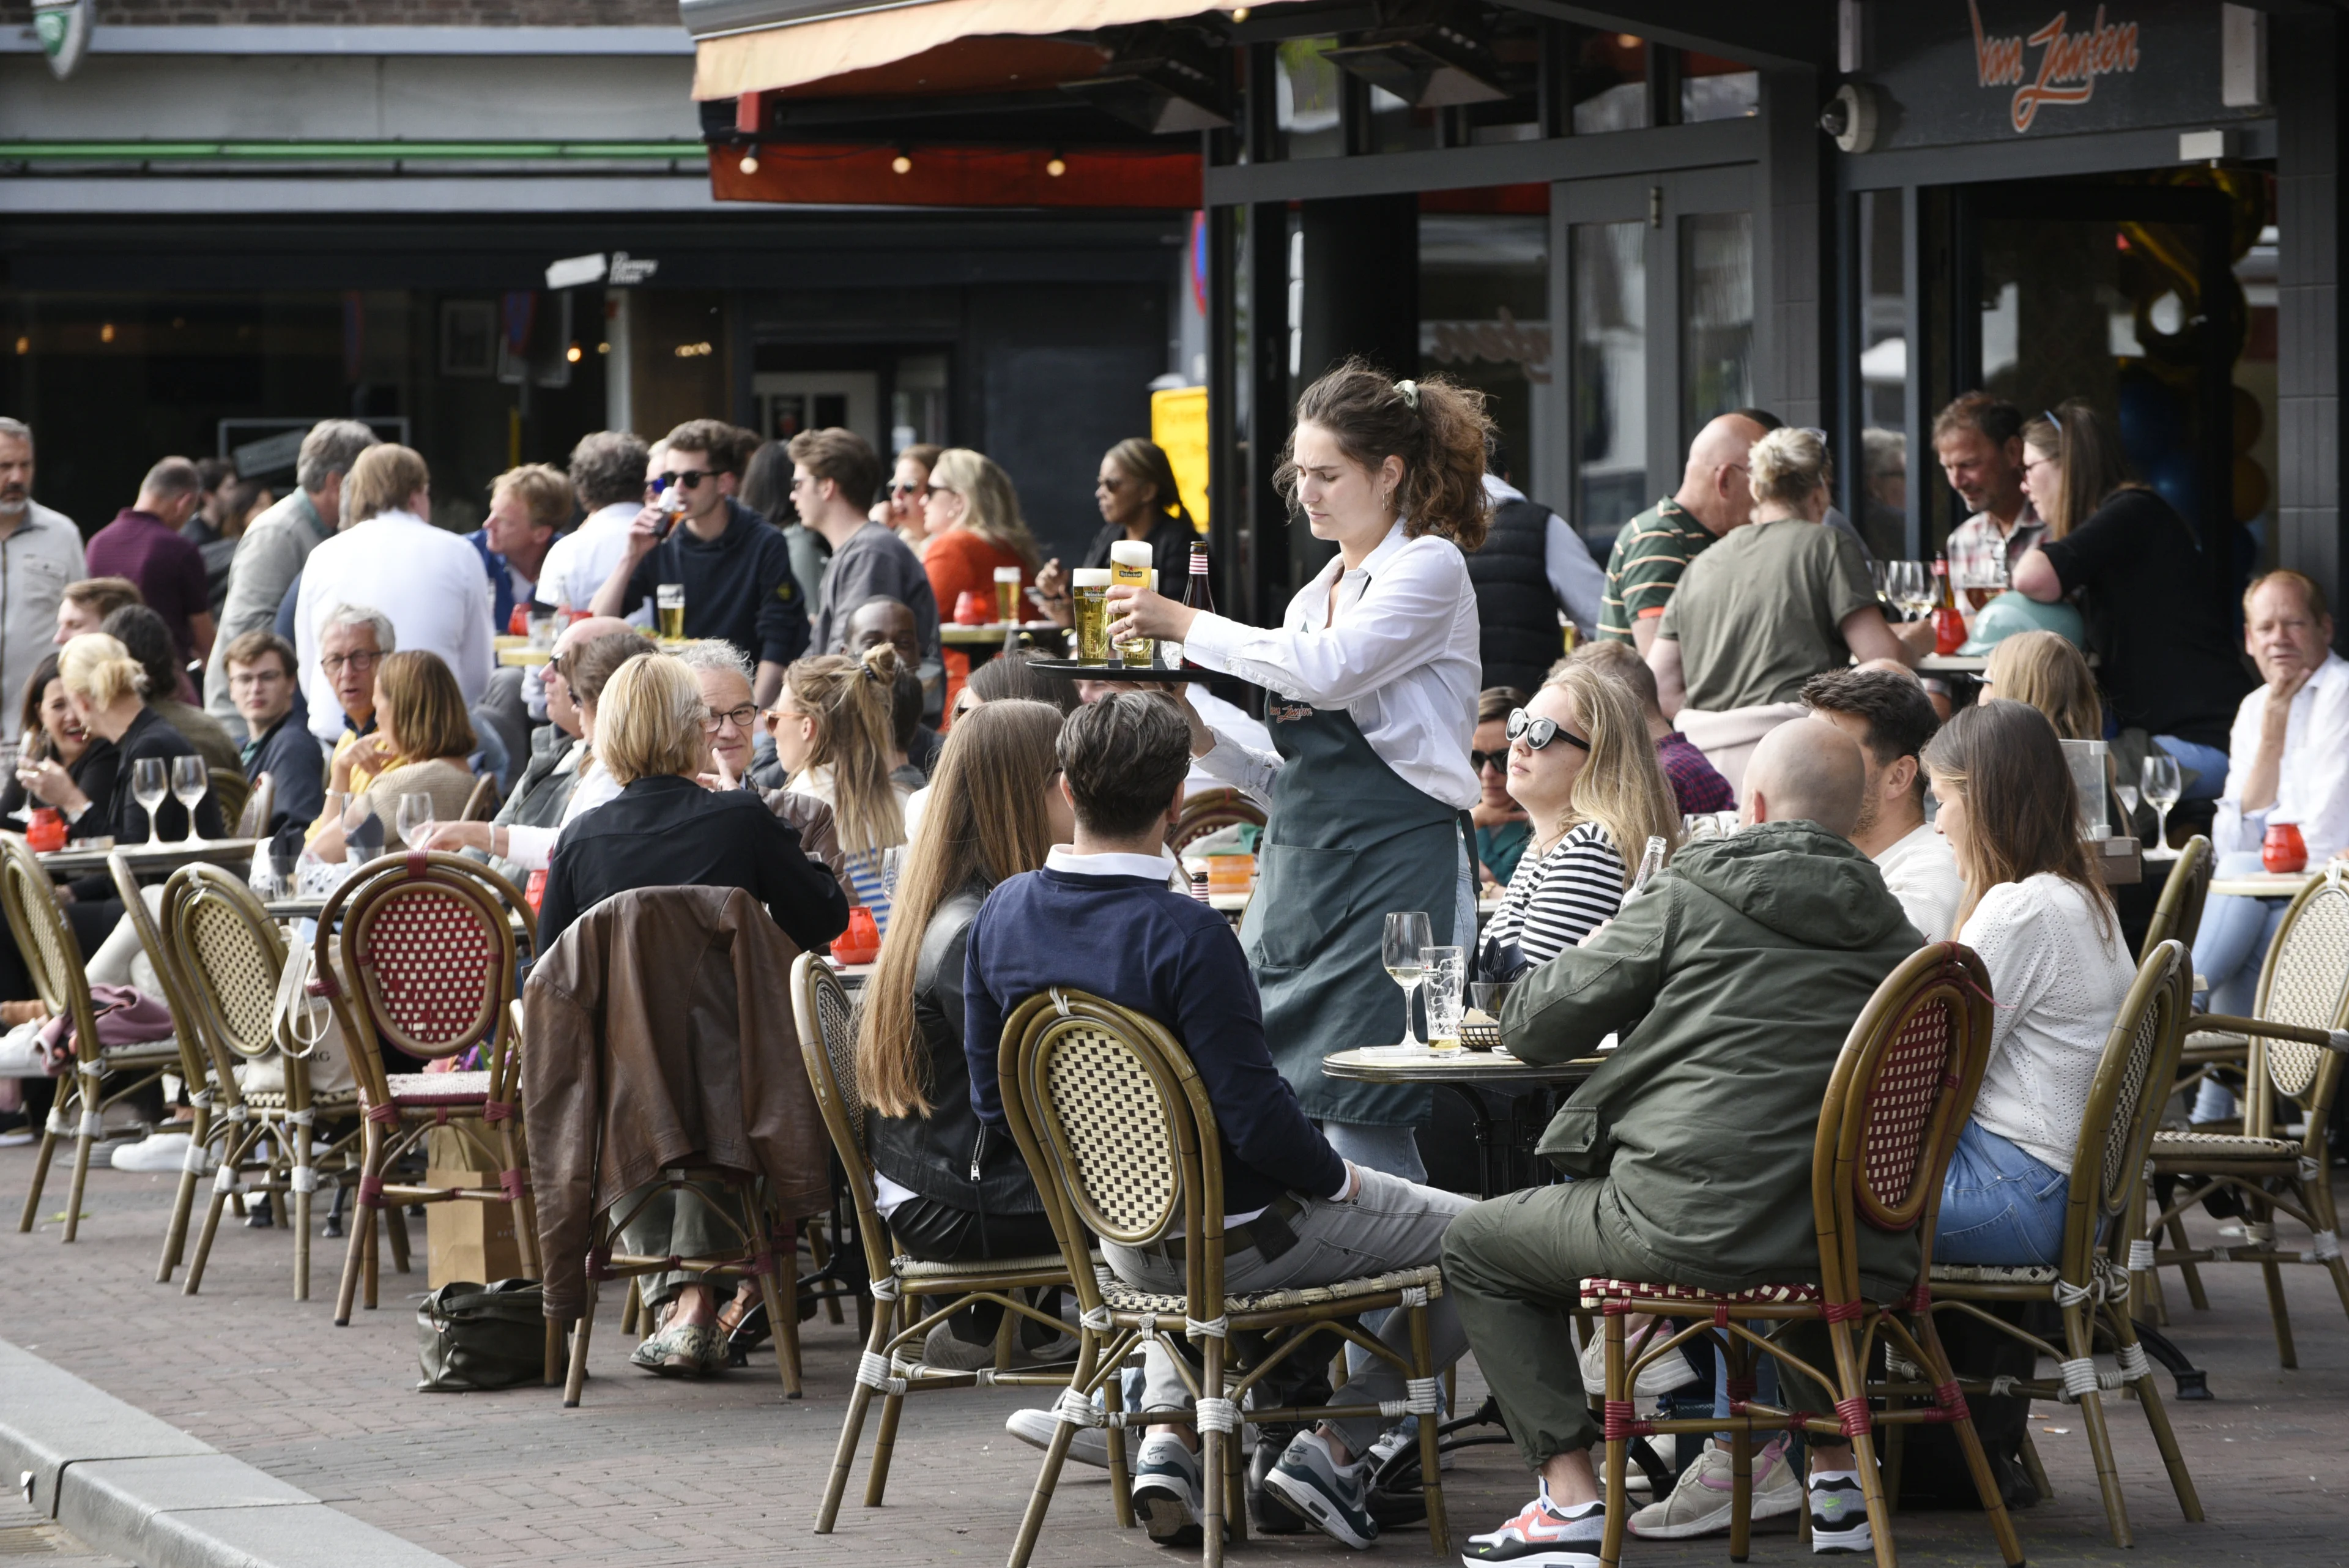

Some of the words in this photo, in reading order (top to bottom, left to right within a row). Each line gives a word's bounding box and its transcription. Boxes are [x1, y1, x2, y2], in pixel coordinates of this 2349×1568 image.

[1969, 0, 2024, 87] Van
[2011, 3, 2140, 133] Zanten
[1276, 704, 1313, 724] Zanten
